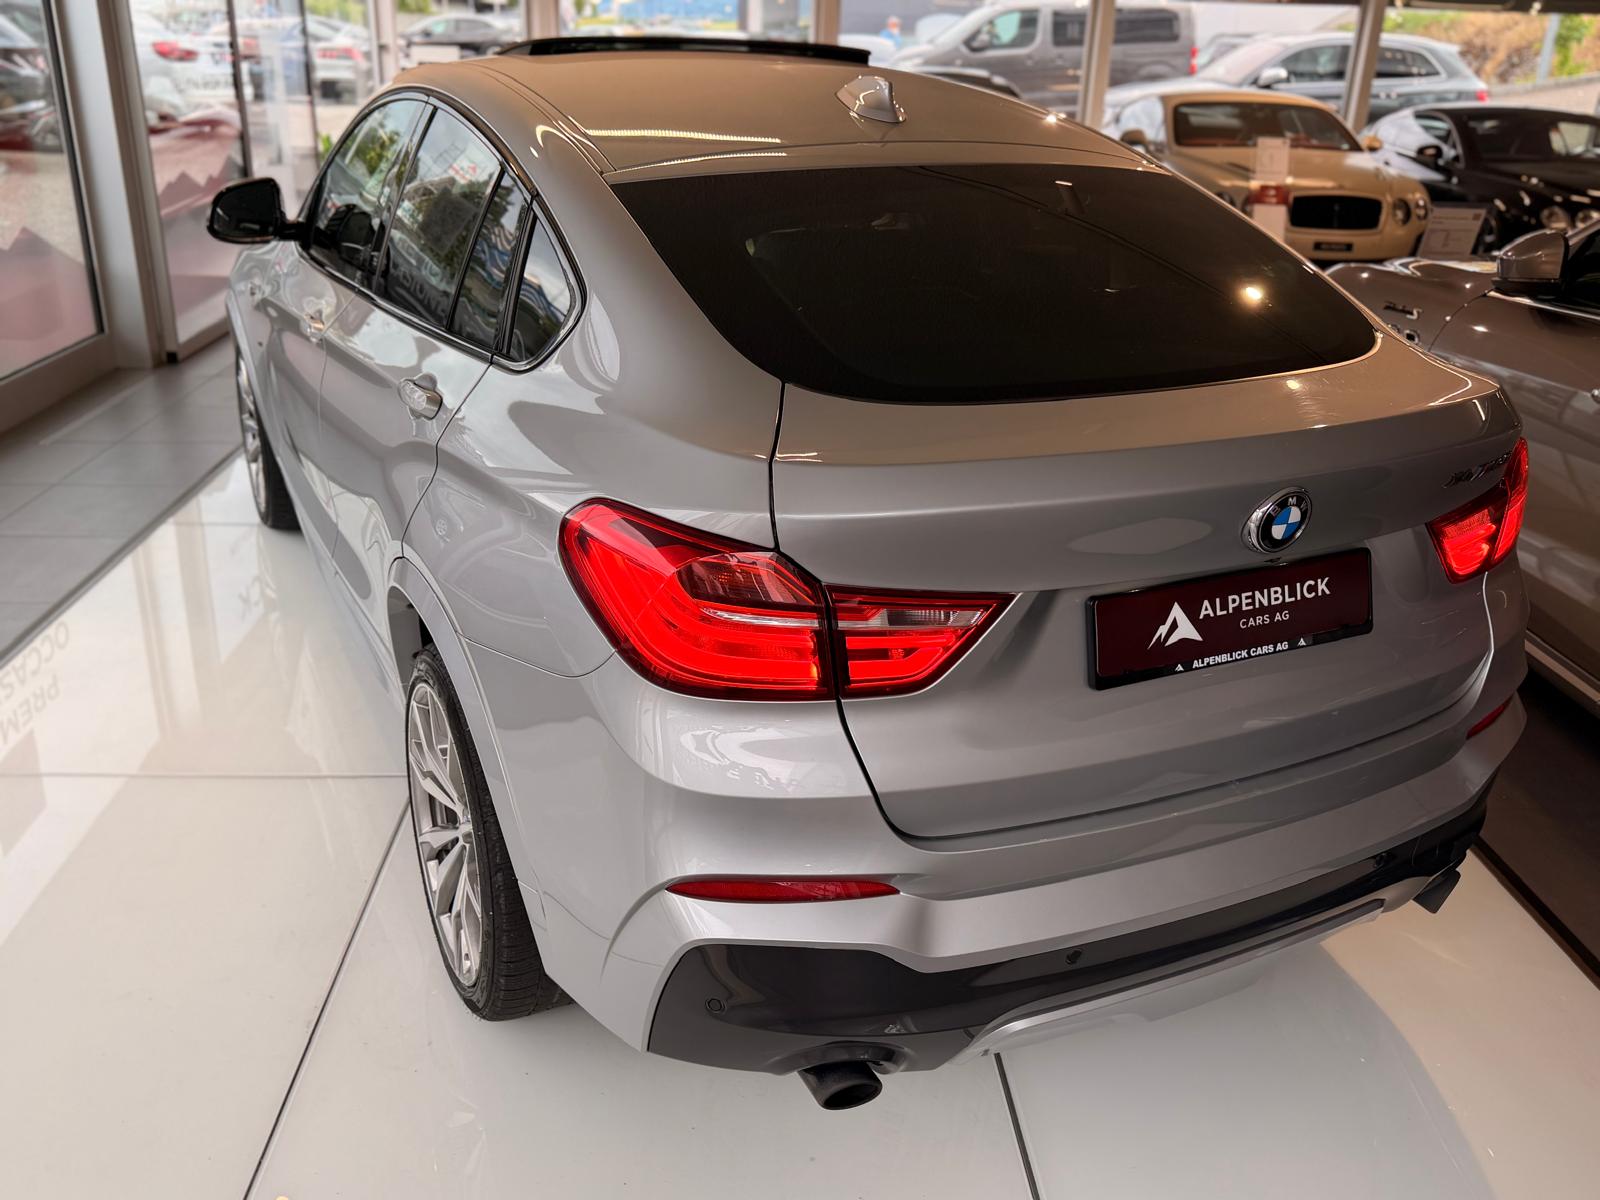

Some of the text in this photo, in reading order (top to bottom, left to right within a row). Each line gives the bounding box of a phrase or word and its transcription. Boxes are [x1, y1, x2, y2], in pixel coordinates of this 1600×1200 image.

[1199, 577, 1332, 620] ALPENBLICK
[1240, 611, 1290, 629] CARS AG
[1193, 642, 1289, 668] ALPENBLICK CARS AG
